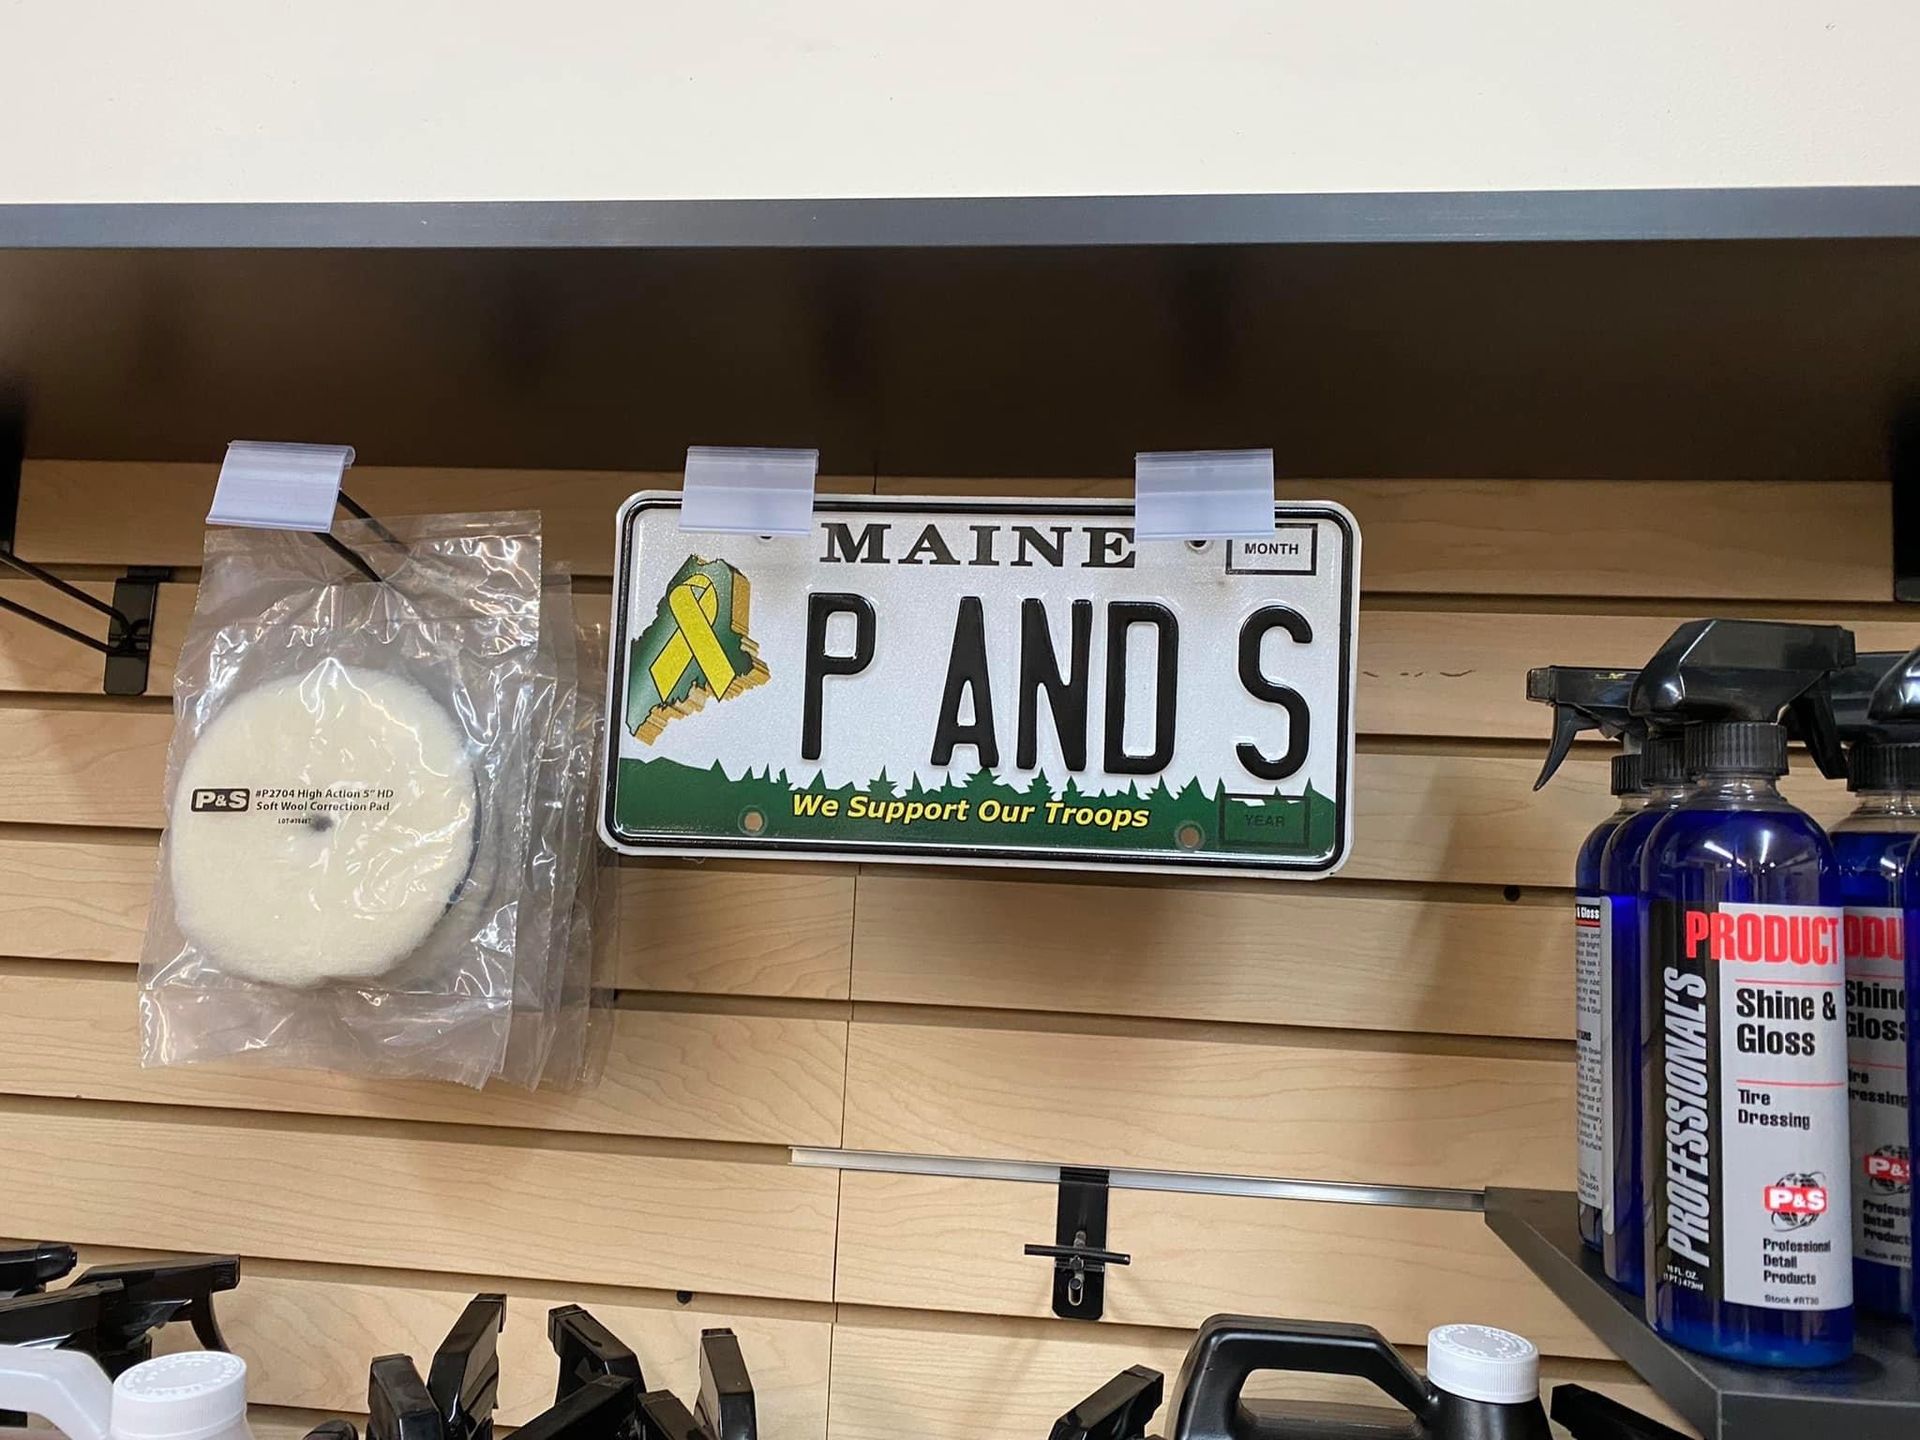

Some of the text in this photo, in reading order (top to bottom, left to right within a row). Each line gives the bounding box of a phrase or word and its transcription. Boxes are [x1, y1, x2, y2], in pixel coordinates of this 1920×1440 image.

[820, 522, 1136, 568] MAINE
[1244, 541, 1299, 556] MONTH
[800, 592, 1314, 780] P AND S
[194, 789, 249, 811] P&S
[255, 789, 295, 799] #P2704
[297, 788, 323, 800] High
[325, 789, 361, 799] Action
[377, 789, 394, 799] HD
[256, 801, 390, 812] Soft Wool Correction Pad
[791, 793, 1149, 830] We Support Our Troops
[1244, 814, 1286, 828] YEAR
[1580, 906, 1600, 919] Gloss
[1685, 910, 1839, 966] PRODUCT
[1736, 988, 1837, 1021] Shine &
[1737, 1023, 1816, 1056] Gloss
[1738, 1088, 1771, 1106] Tire
[1664, 966, 1710, 1268] PROFESSIONAL'S
[1738, 1109, 1811, 1131] Dressing
[1768, 1188, 1826, 1211] P&S
[1763, 1238, 1831, 1253] Professional
[1763, 1254, 1798, 1269] Detail
[1763, 1270, 1817, 1285] Products
[1764, 1294, 1791, 1304] Stock
